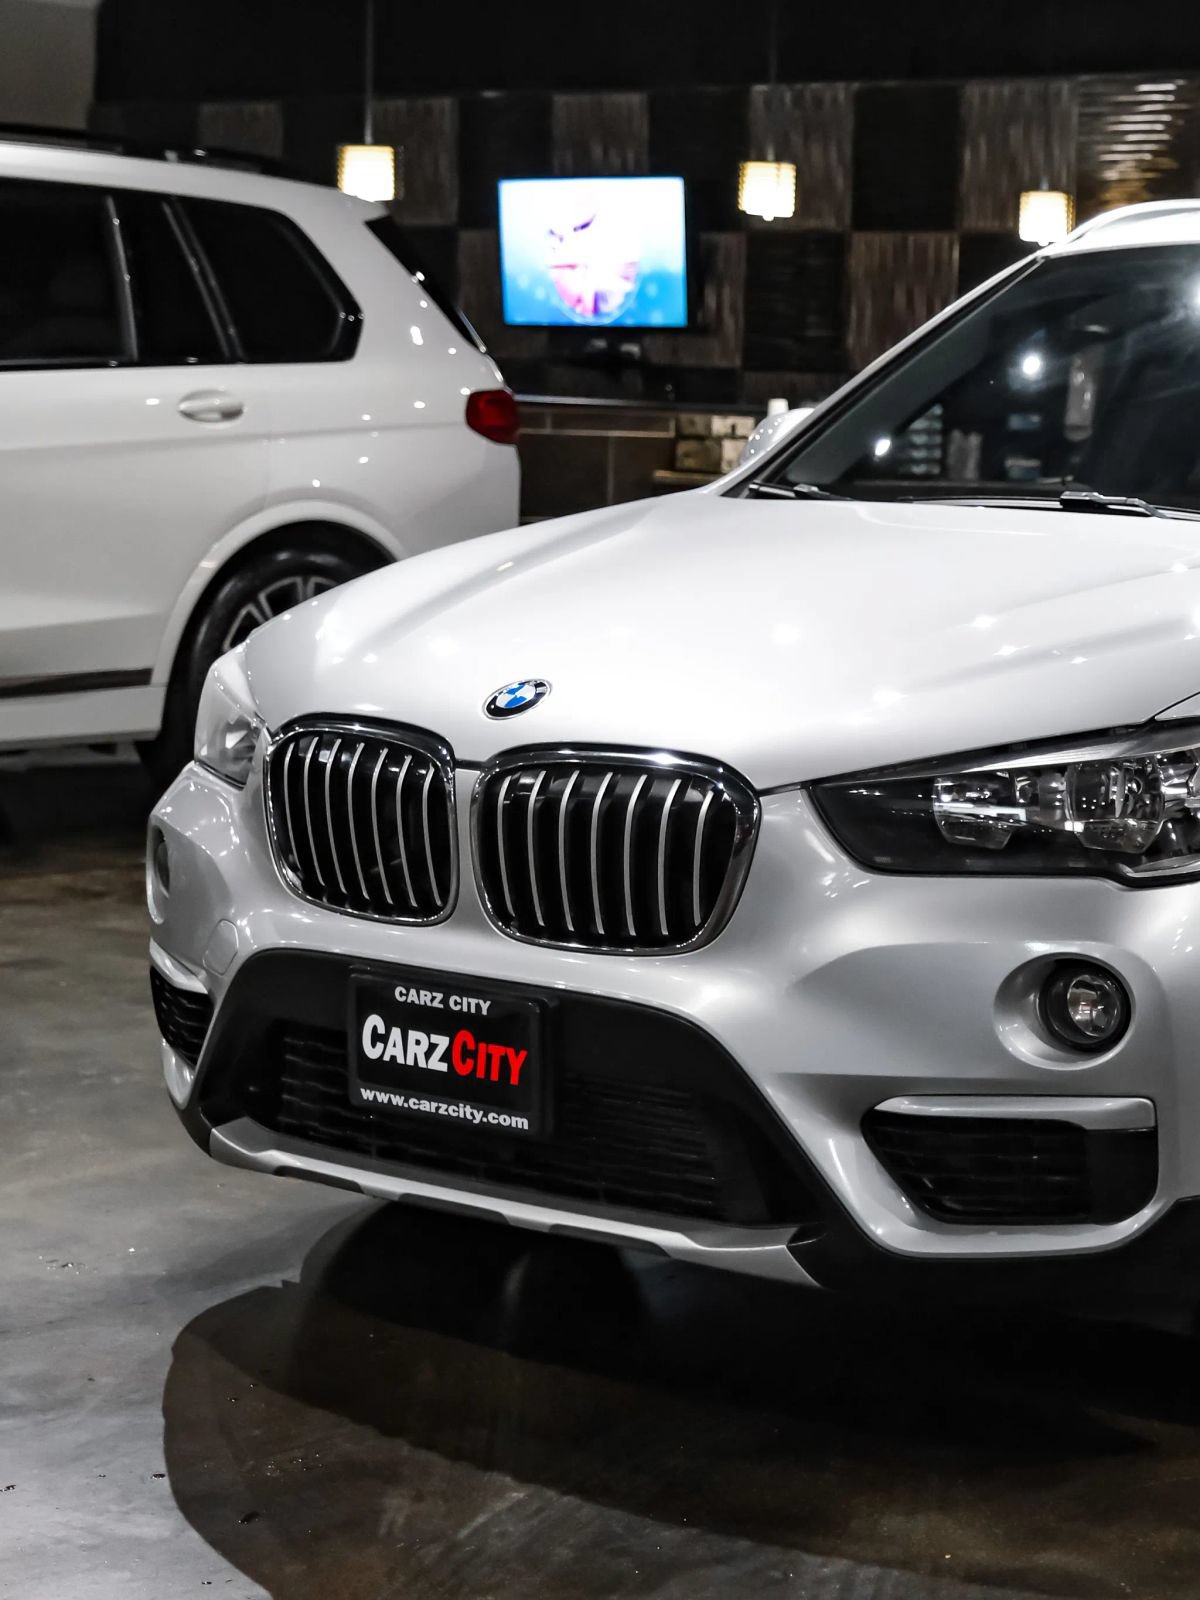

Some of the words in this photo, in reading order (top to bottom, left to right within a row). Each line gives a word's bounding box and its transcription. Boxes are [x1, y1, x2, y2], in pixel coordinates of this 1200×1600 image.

[394, 986, 444, 1009] CARZ
[449, 995, 491, 1016] CITY
[360, 1088, 529, 1130] www.carzcity.com
